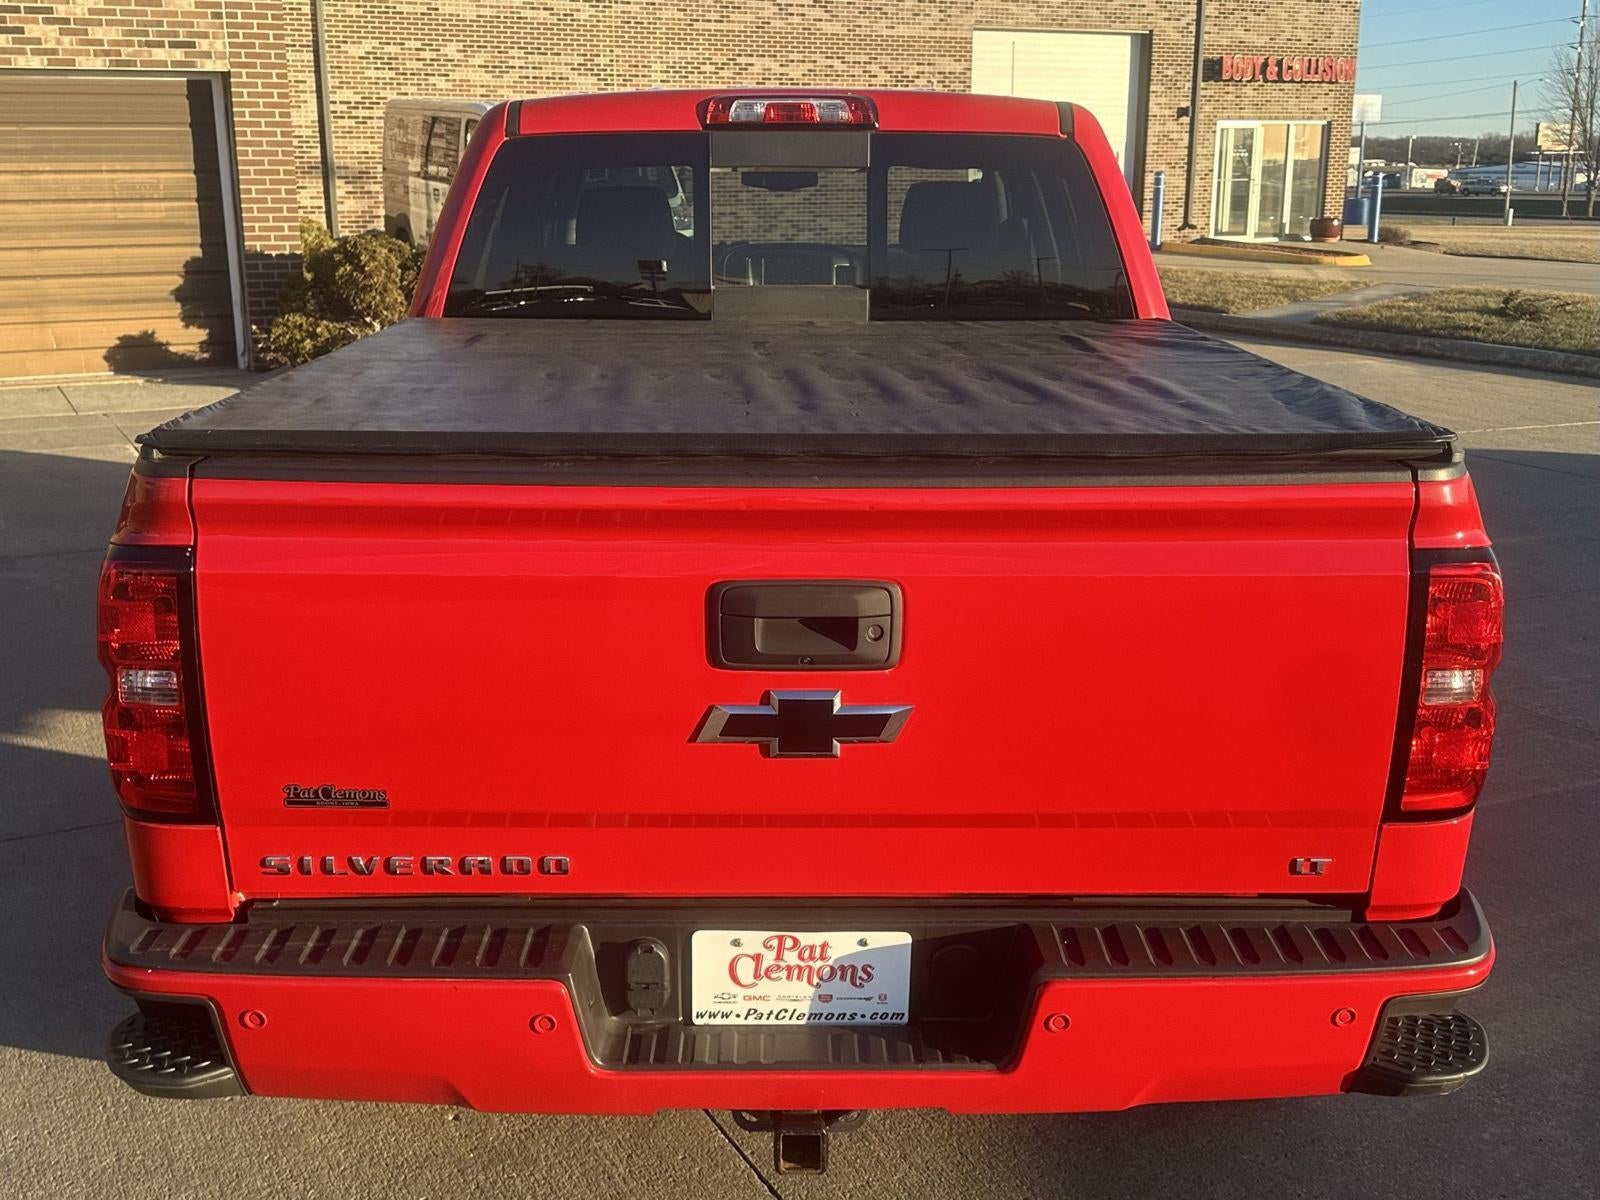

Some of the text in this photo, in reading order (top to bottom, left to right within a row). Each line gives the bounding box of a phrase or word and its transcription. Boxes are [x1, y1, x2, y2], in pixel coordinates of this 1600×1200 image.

[1222, 54, 1356, 82] BODY & COLLISION
[284, 784, 387, 802] Pat Clemons
[261, 855, 572, 876] SILVERADO
[1290, 858, 1333, 875] LT
[762, 934, 832, 963] Pat
[728, 953, 875, 989] Clemons
[743, 994, 771, 1002] GMC
